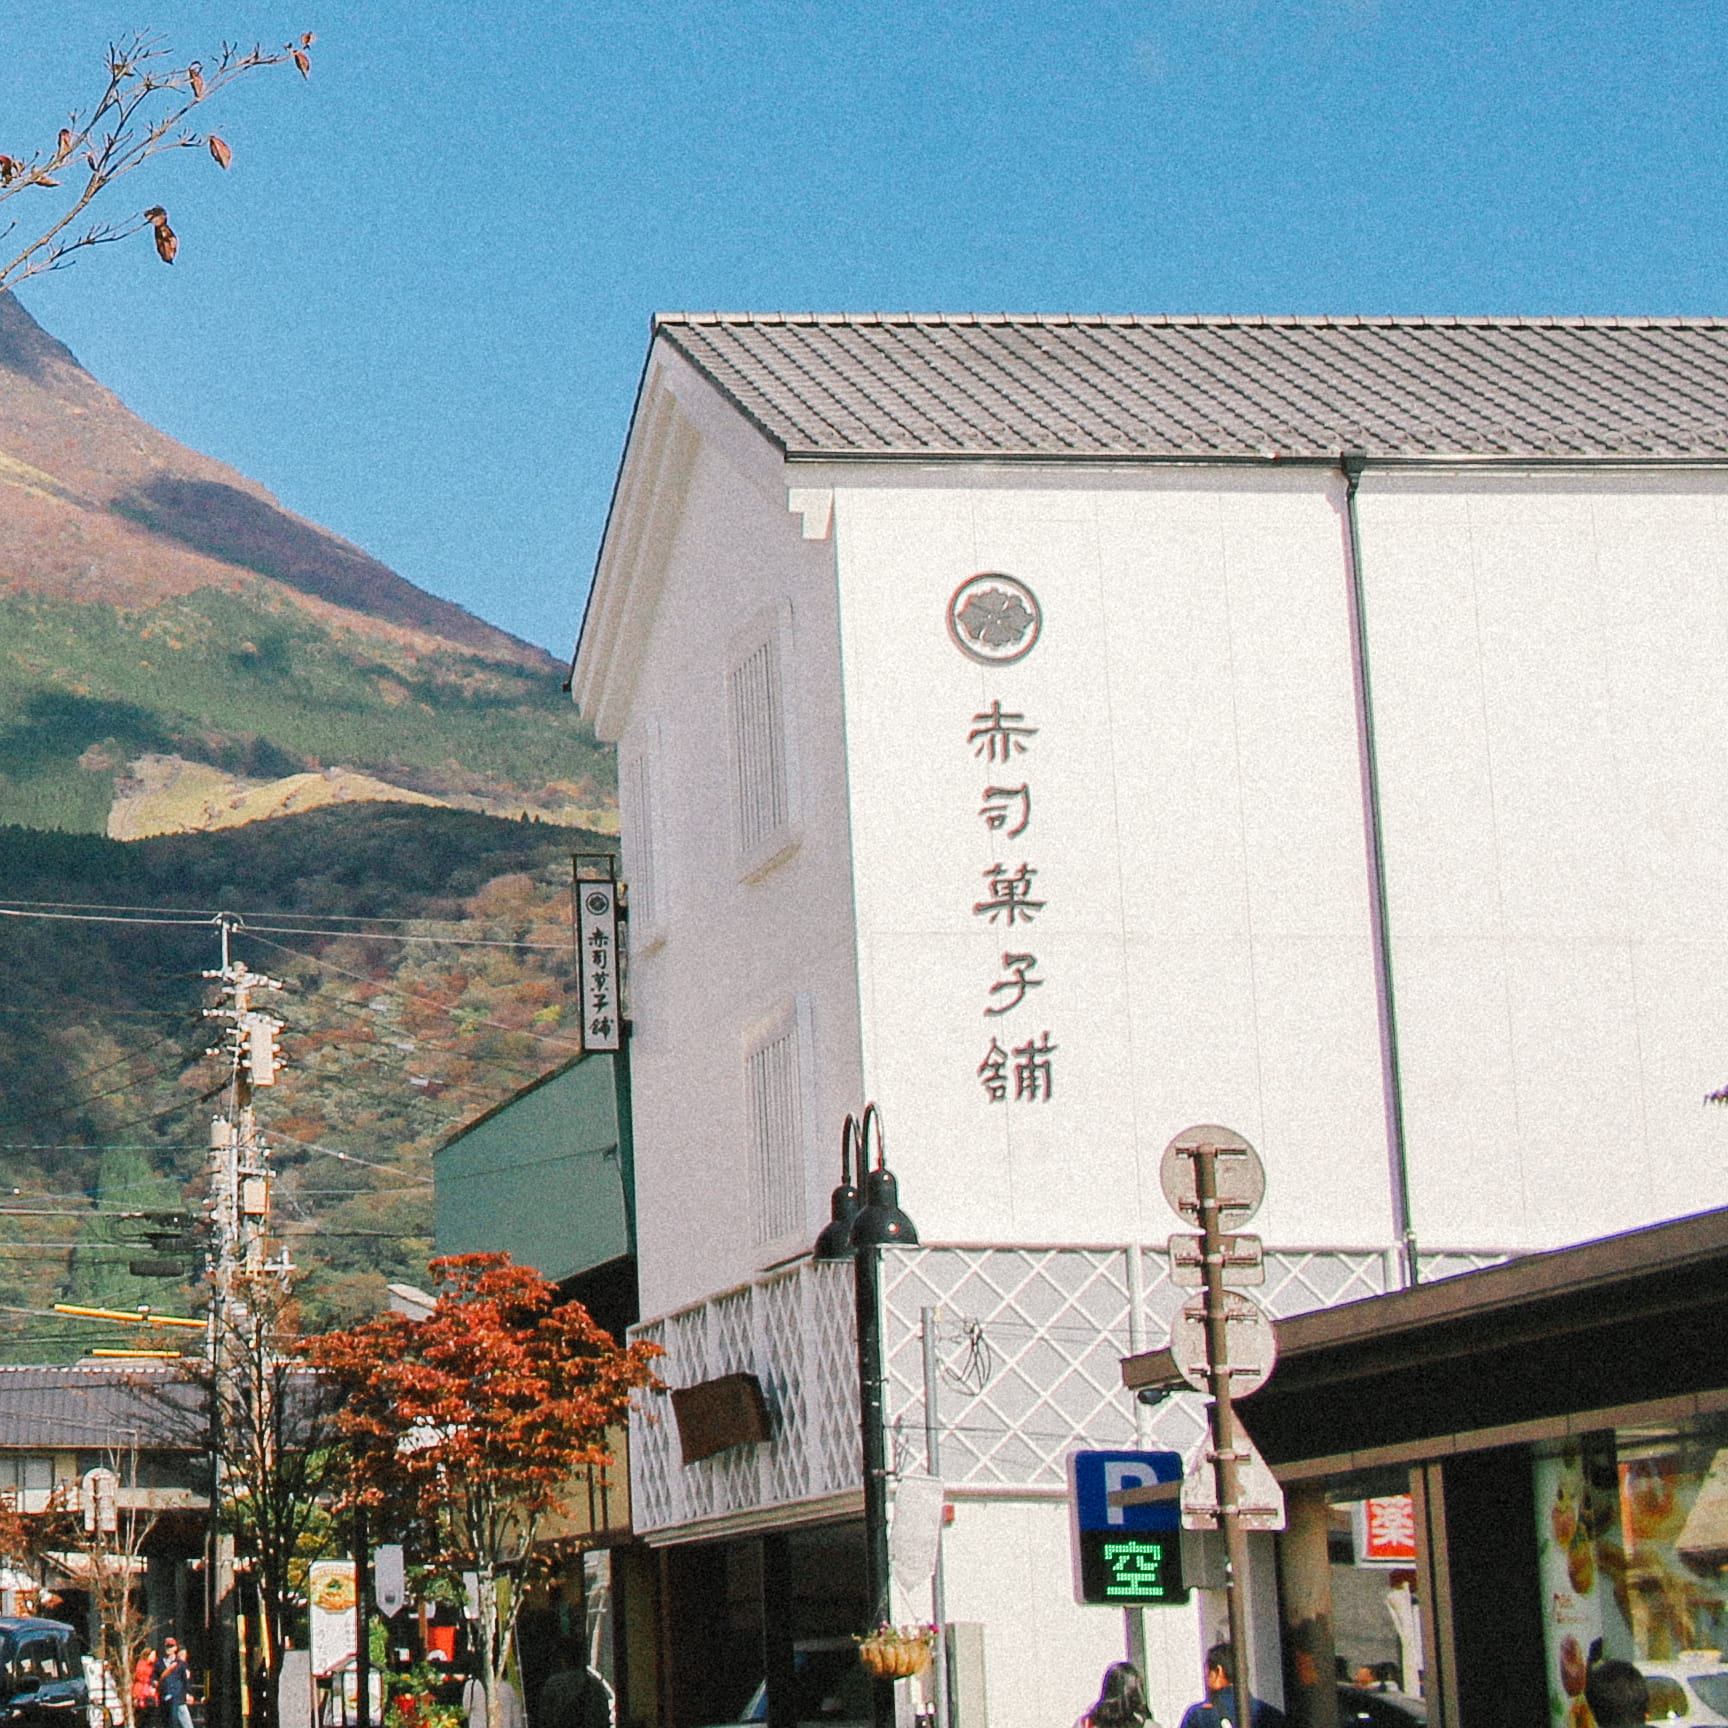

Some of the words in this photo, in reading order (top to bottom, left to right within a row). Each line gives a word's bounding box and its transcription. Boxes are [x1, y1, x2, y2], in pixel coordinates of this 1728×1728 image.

[966, 700, 1058, 1103] 赤司菓子舗
[588, 926, 614, 1040] 赤司菓子舗
[1104, 1462, 1158, 1524] P
[1104, 1541, 1163, 1595] 空
